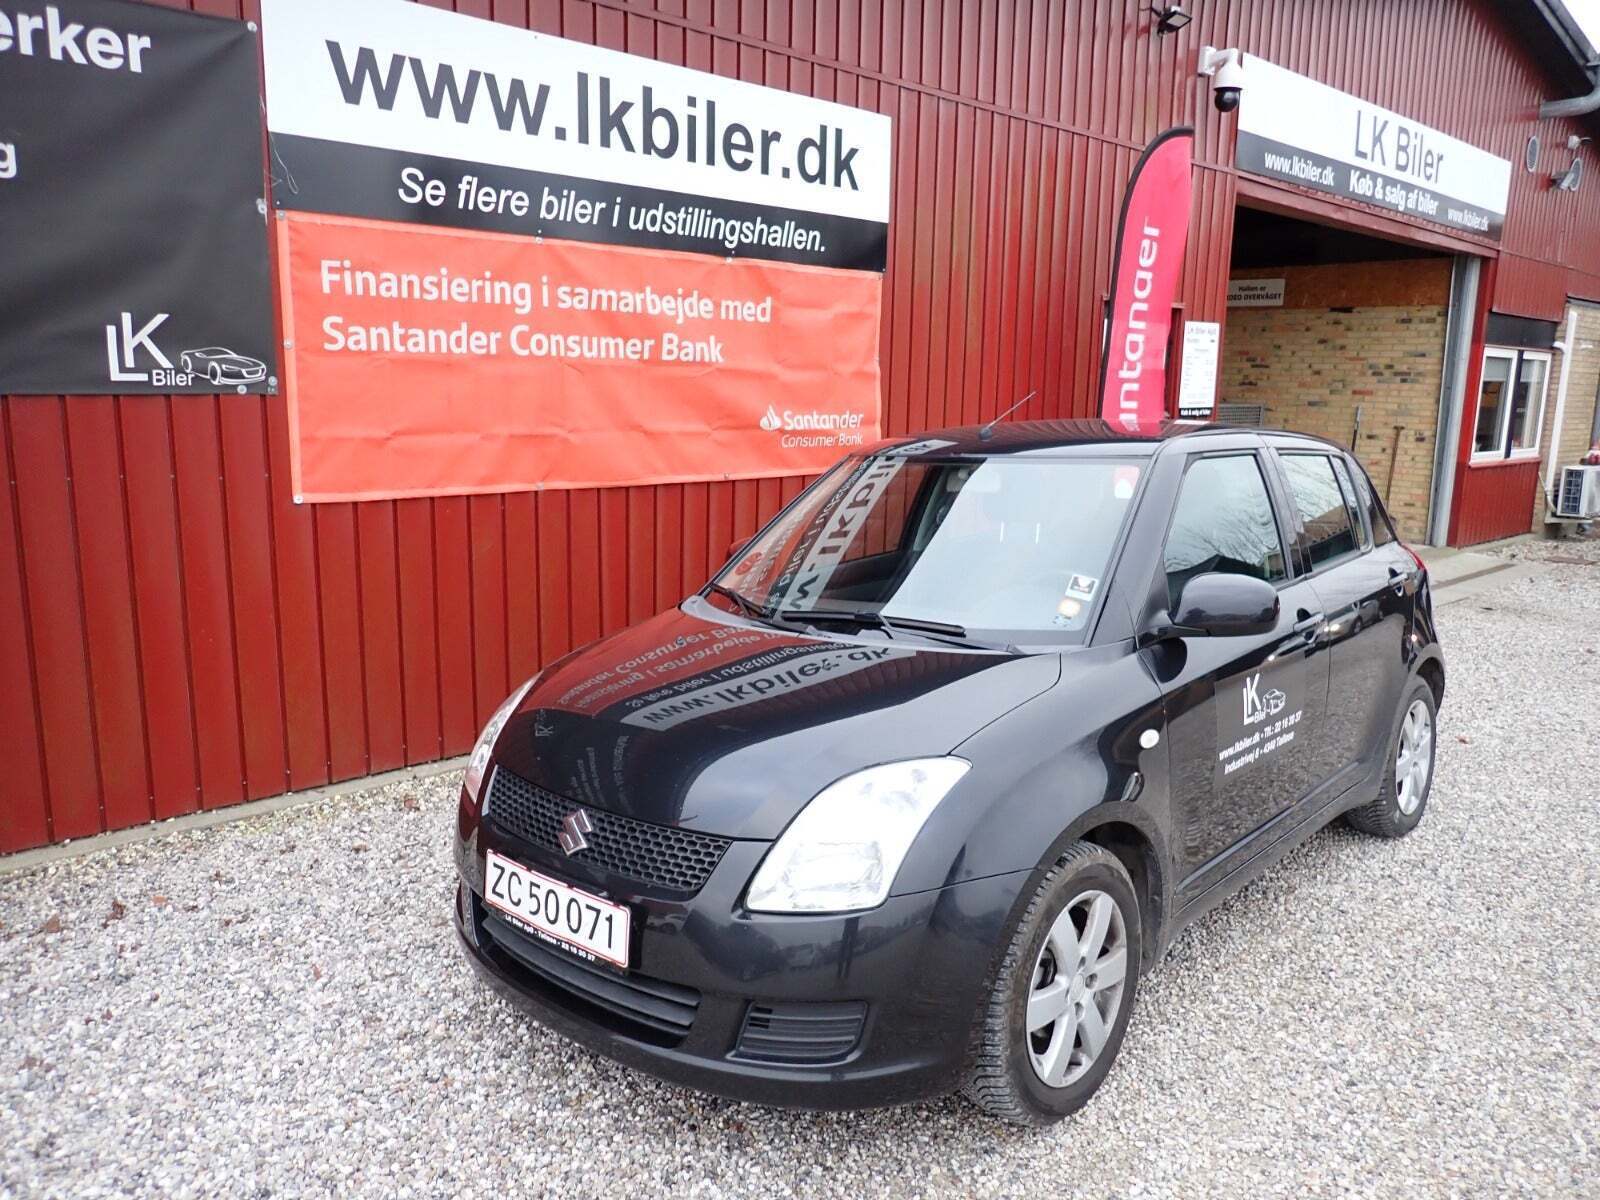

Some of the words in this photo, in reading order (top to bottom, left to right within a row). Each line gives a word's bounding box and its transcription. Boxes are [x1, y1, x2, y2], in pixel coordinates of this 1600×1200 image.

[325, 40, 860, 191] www.lkbiler.dk
[1264, 152, 1335, 187] www.lkbiler.dk
[1354, 110, 1389, 166] LK
[1394, 125, 1444, 185] Biler
[398, 167, 446, 207] Se
[457, 175, 529, 217] flere
[539, 187, 606, 226] biler
[612, 196, 621, 227] i
[628, 200, 826, 252] udstillingshallen.
[1350, 169, 1374, 196] Køb
[1374, 177, 1383, 199] &
[1384, 183, 1407, 210] salg
[1407, 191, 1418, 209] af
[1418, 191, 1439, 216] biler
[320, 259, 532, 315] Finansiering
[541, 276, 548, 310] i
[557, 283, 714, 325] samarbejde
[720, 297, 772, 323] med
[106, 312, 174, 382] LK
[322, 316, 502, 355] Santander
[509, 325, 654, 361] Consumer
[661, 332, 724, 364] Bank
[152, 370, 194, 387] Biler
[782, 434, 837, 448] Consumer
[838, 433, 863, 446] Bank
[783, 410, 864, 431] Santander
[1243, 673, 1262, 725] LK
